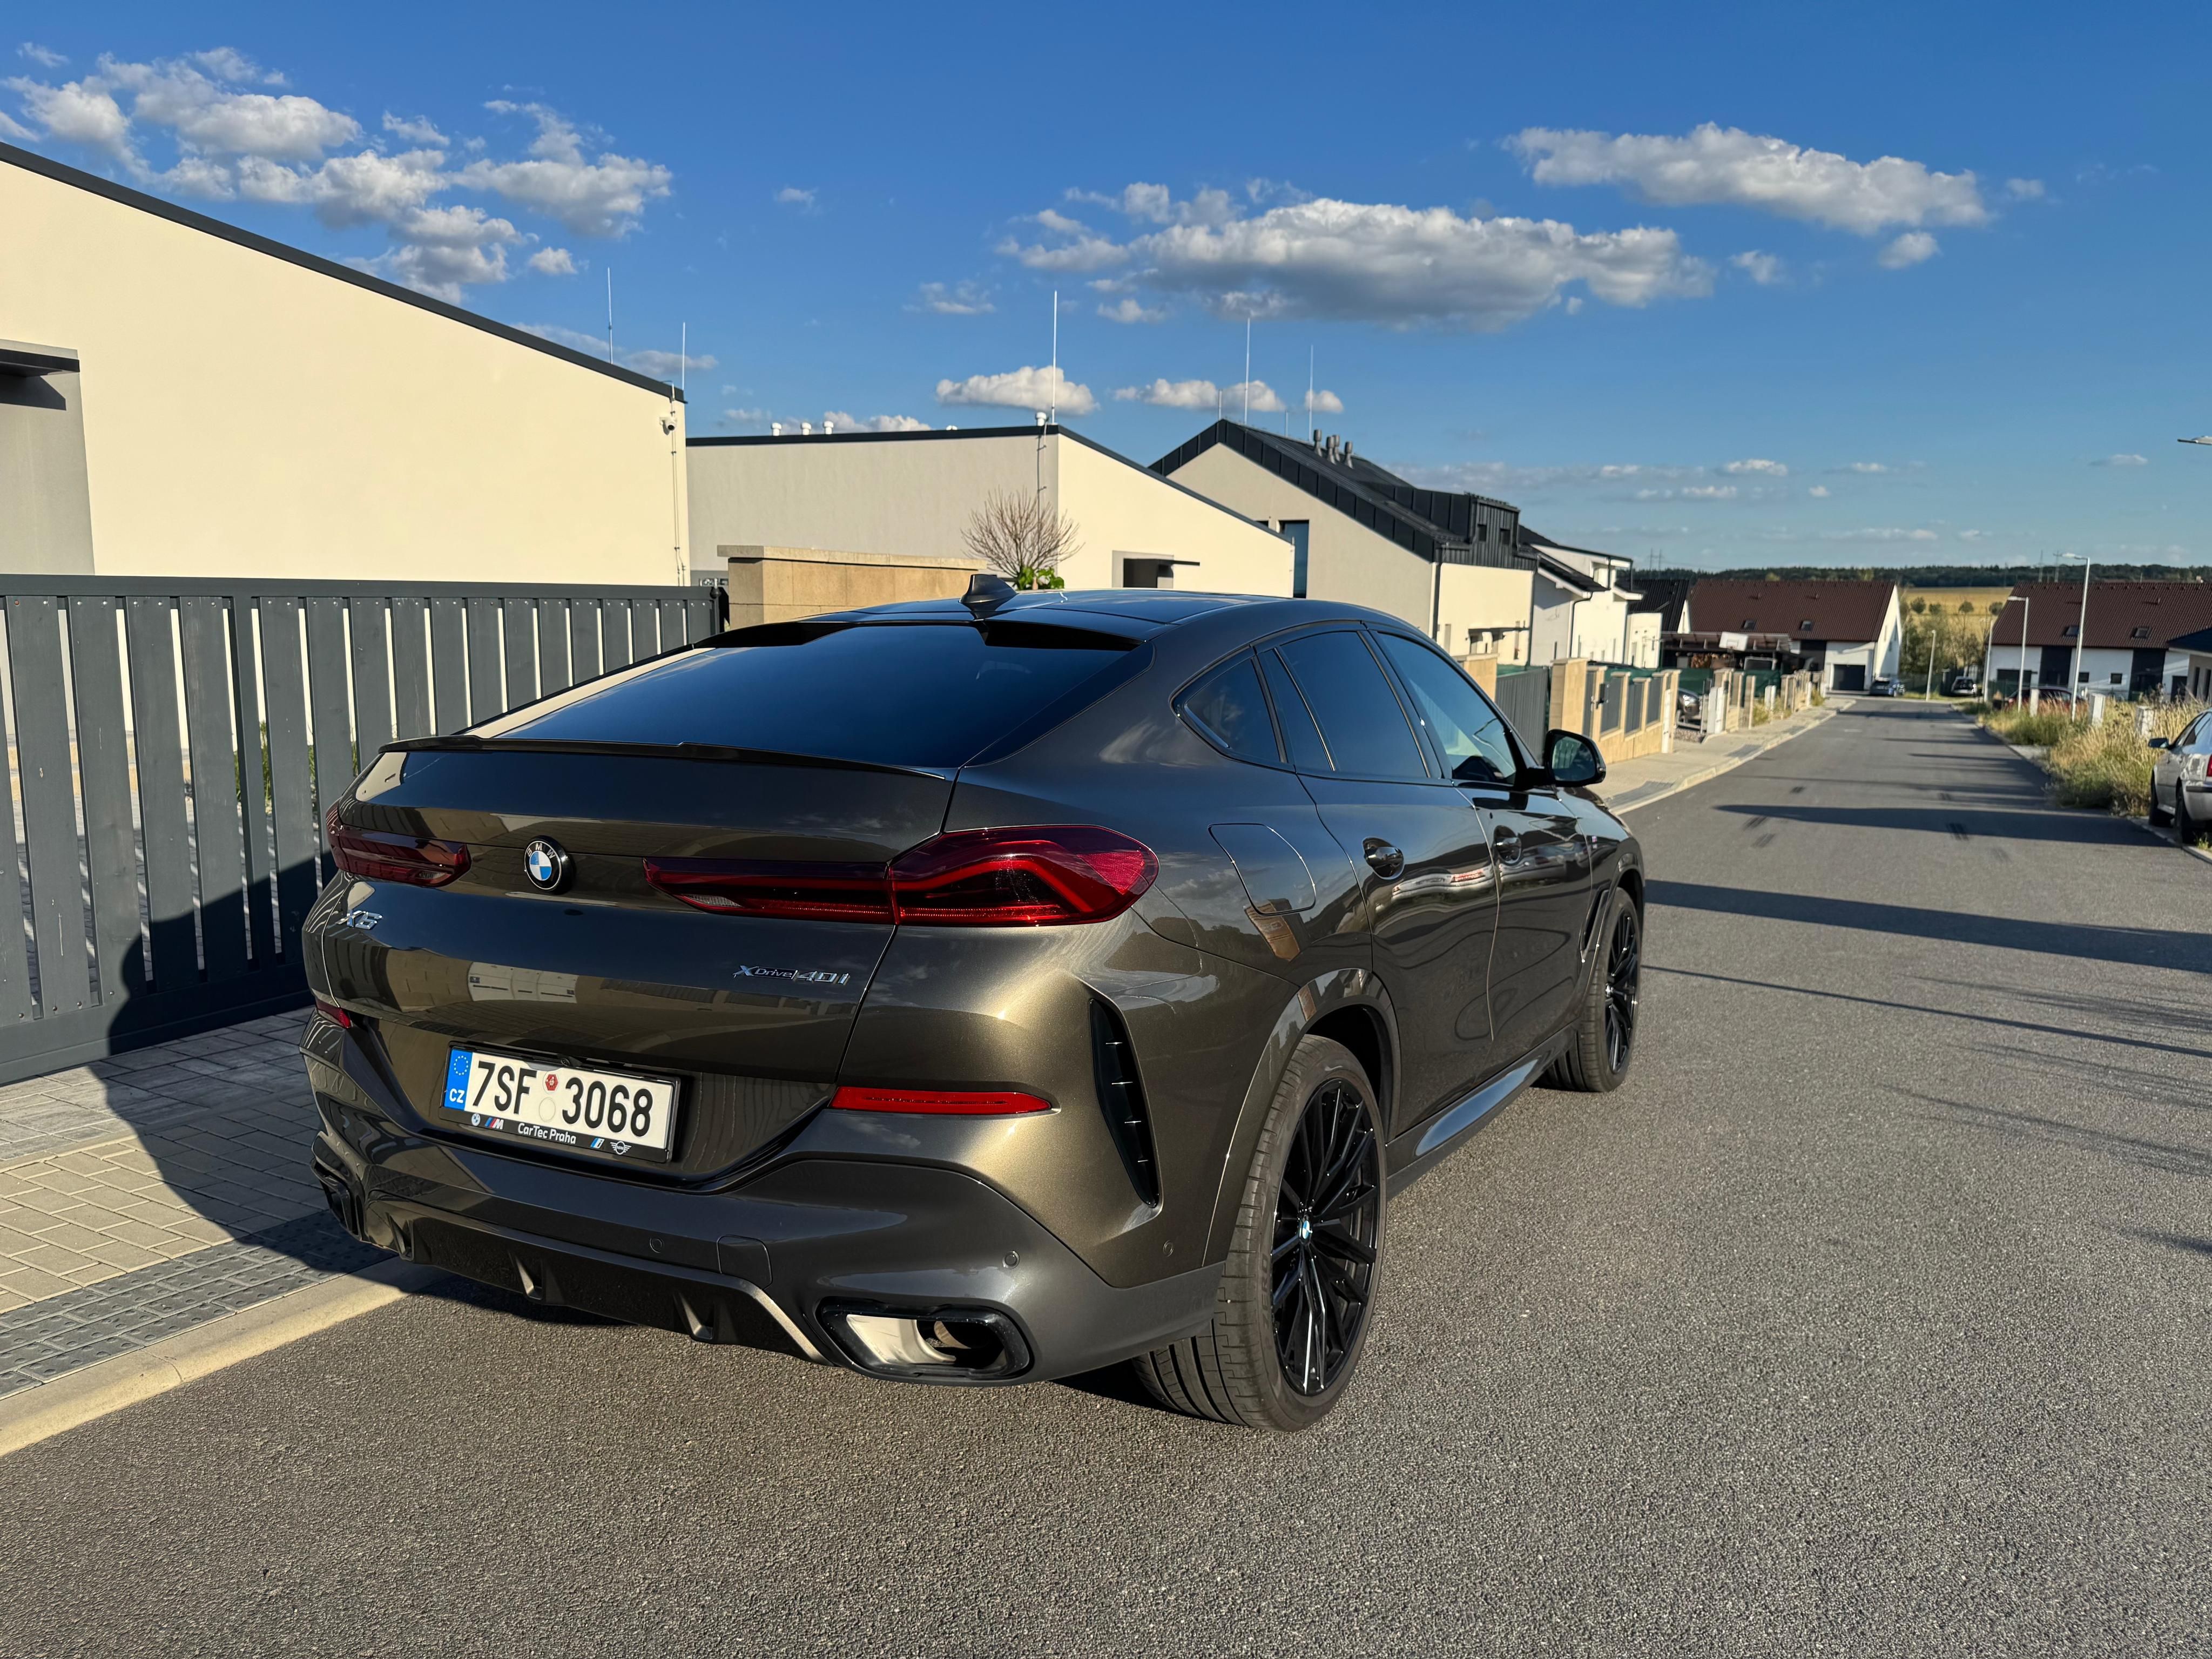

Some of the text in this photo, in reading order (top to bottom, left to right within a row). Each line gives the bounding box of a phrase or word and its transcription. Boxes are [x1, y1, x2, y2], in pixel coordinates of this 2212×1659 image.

[527, 843, 555, 859] BMW
[335, 909, 382, 930] X6
[449, 1089, 464, 1103] CZ
[473, 1061, 653, 1137] 7SF 3068
[518, 1123, 577, 1144] CarTec Praha
